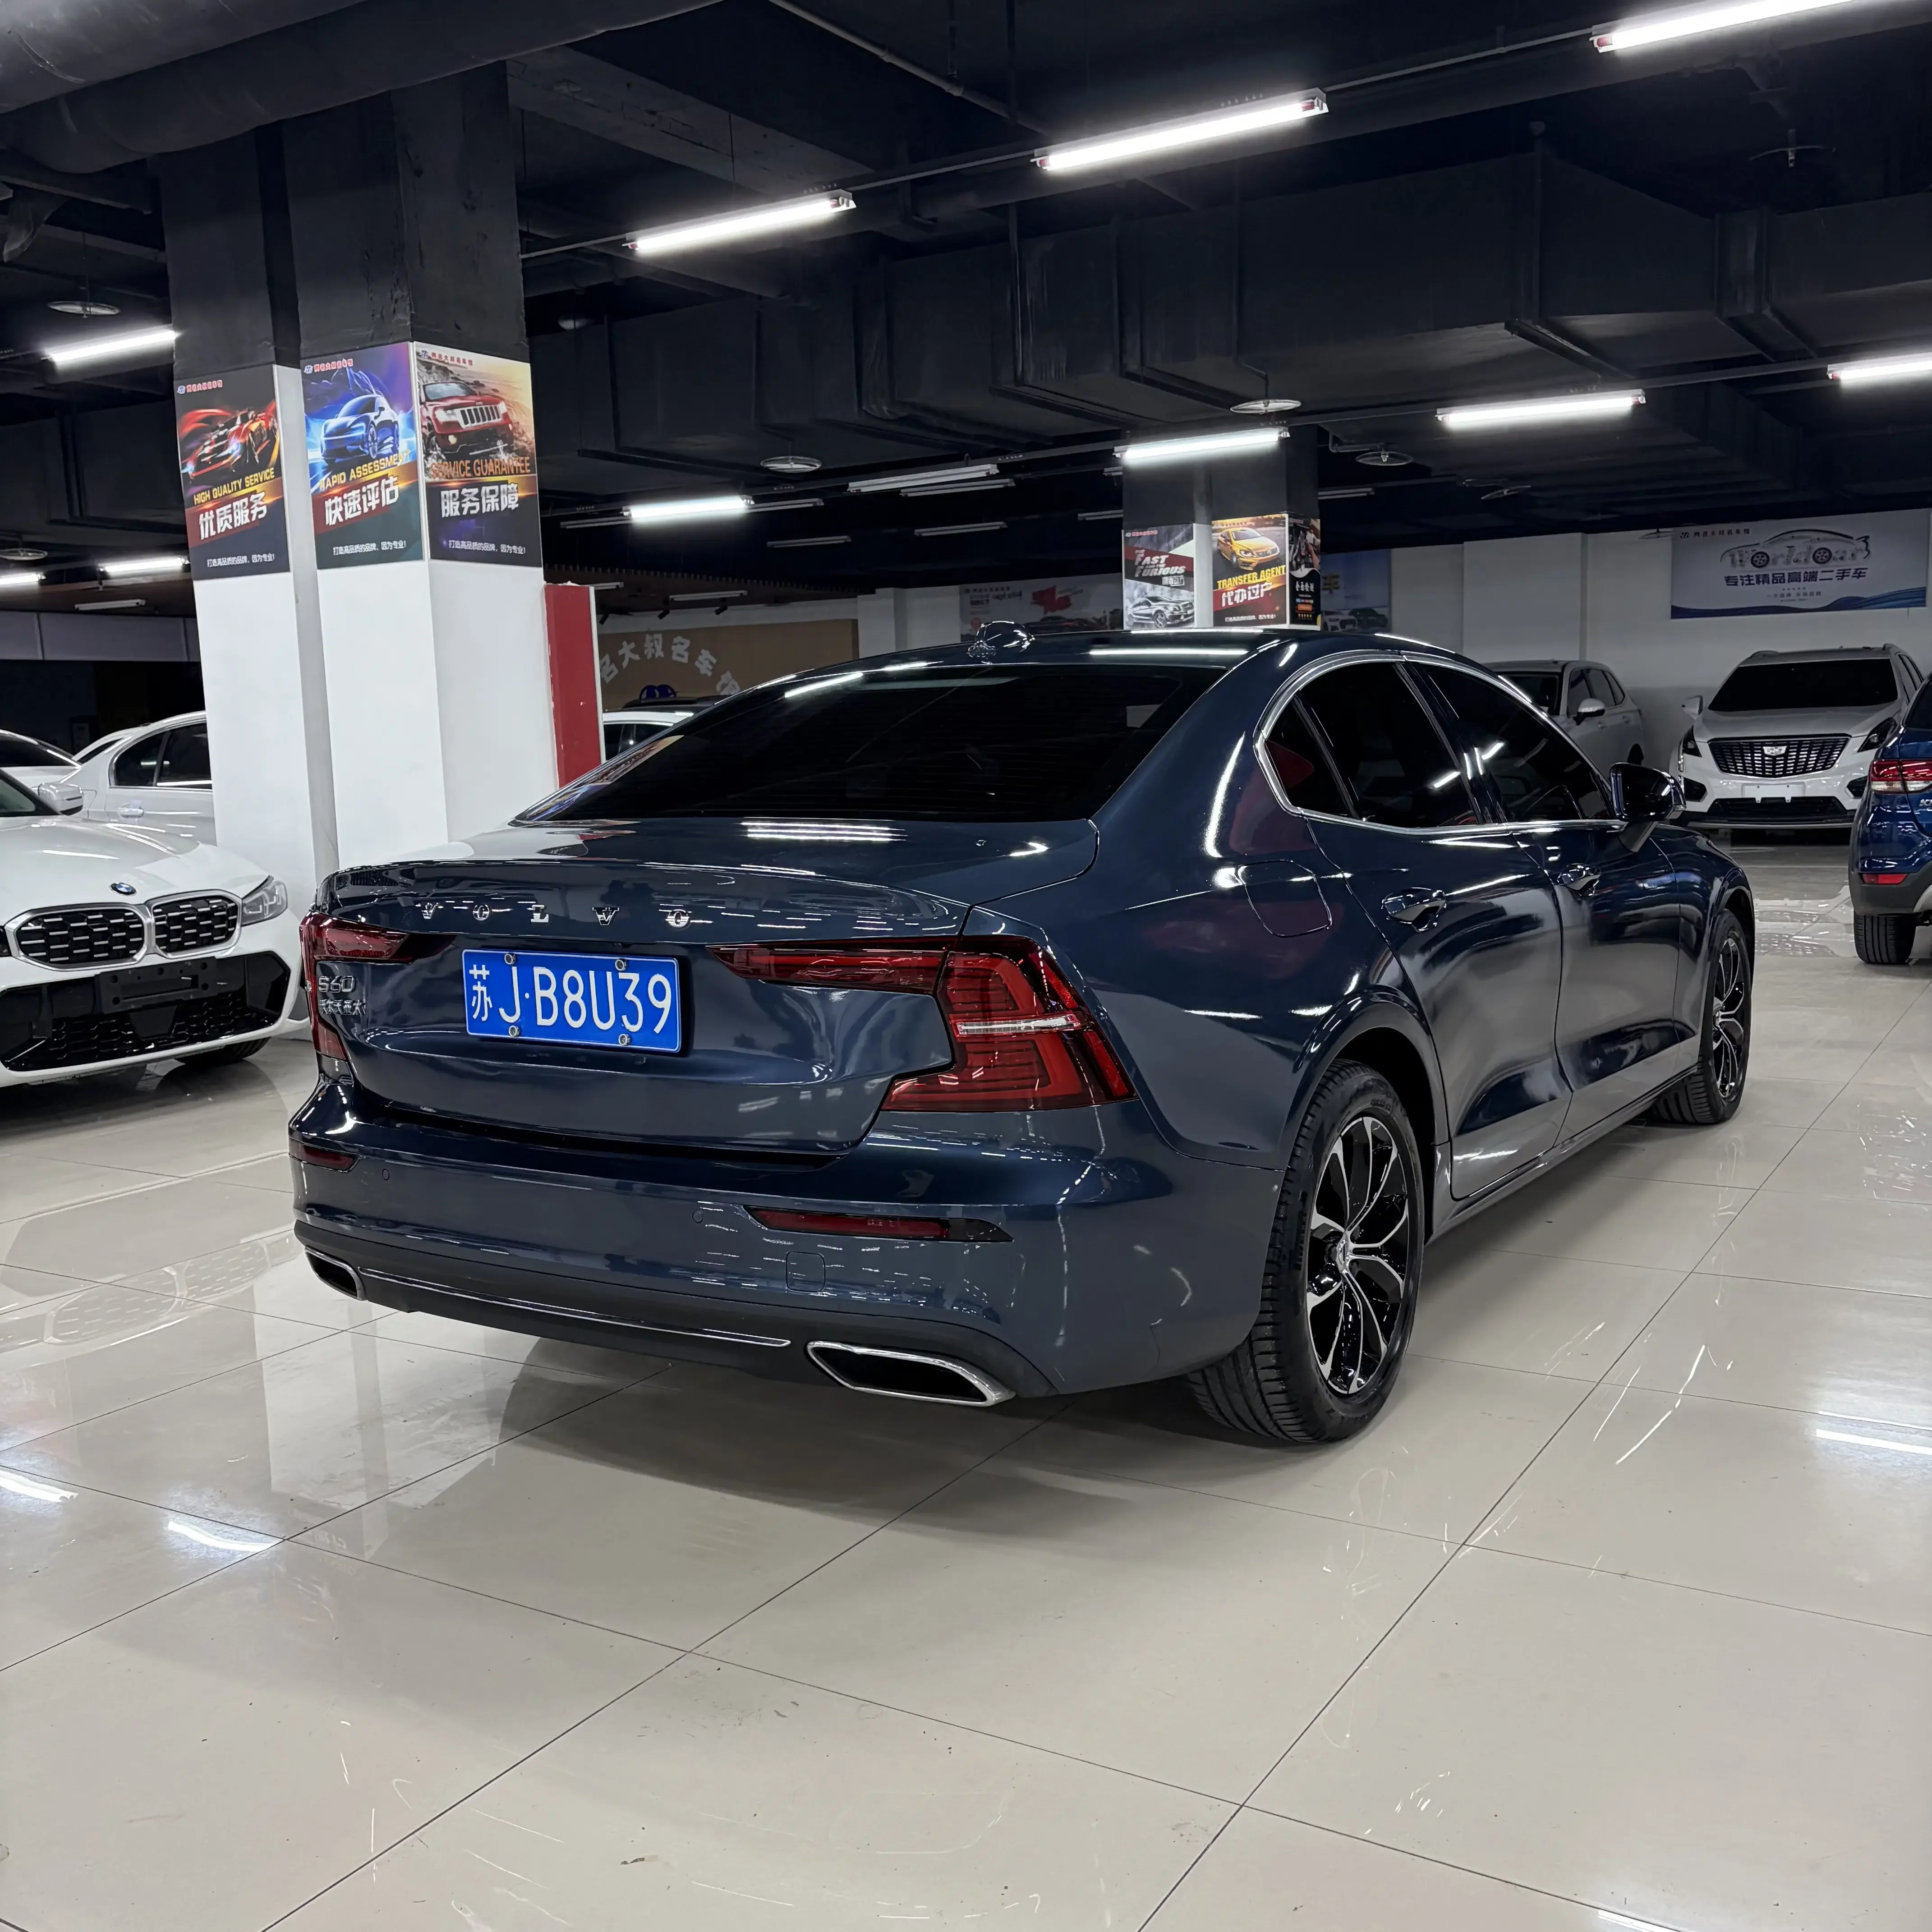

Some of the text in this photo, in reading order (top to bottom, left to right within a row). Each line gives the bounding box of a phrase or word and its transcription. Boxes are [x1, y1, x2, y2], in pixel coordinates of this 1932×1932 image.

[319, 449, 409, 491] RAPID ASSESSMENT
[430, 456, 531, 479] SERVICE GUARANTEE
[193, 467, 275, 505] HIGH QUALITY SERVICE
[325, 476, 399, 526] 快速评估
[441, 483, 519, 518] 服务保障
[199, 491, 267, 540] 优质服务
[1217, 565, 1286, 589] TRANSFER AGENT
[1724, 567, 1868, 587] 专注精品高端二手车
[1221, 582, 1273, 607] 代办过户
[421, 902, 692, 929] VOLVO
[318, 975, 355, 993] S60
[469, 964, 672, 1034] 苏J·B8U39
